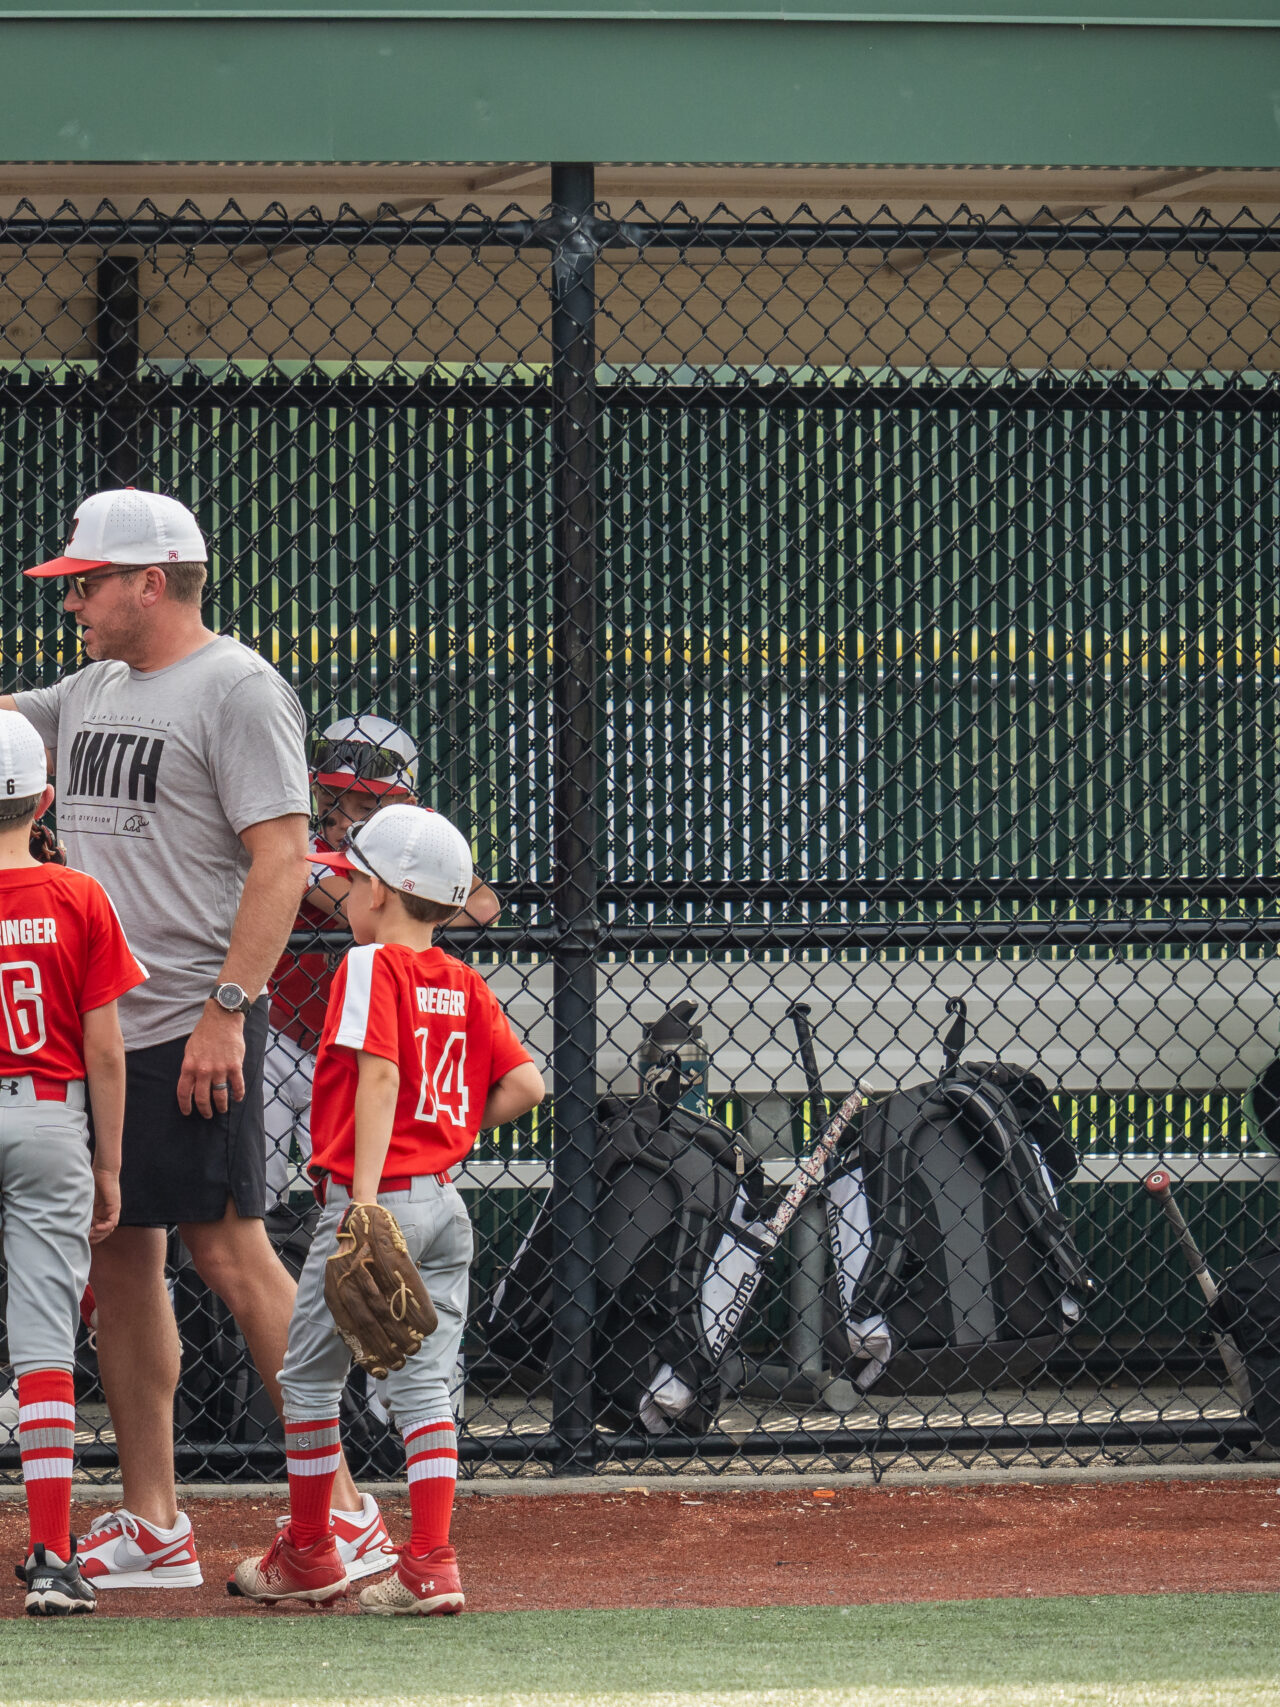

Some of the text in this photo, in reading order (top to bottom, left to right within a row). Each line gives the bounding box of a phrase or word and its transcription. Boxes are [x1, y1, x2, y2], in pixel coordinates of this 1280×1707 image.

[6, 778, 15, 796] 6
[451, 886, 466, 902] 14
[414, 1026, 469, 1128] 14
[31, 1577, 54, 1590] NIKE
